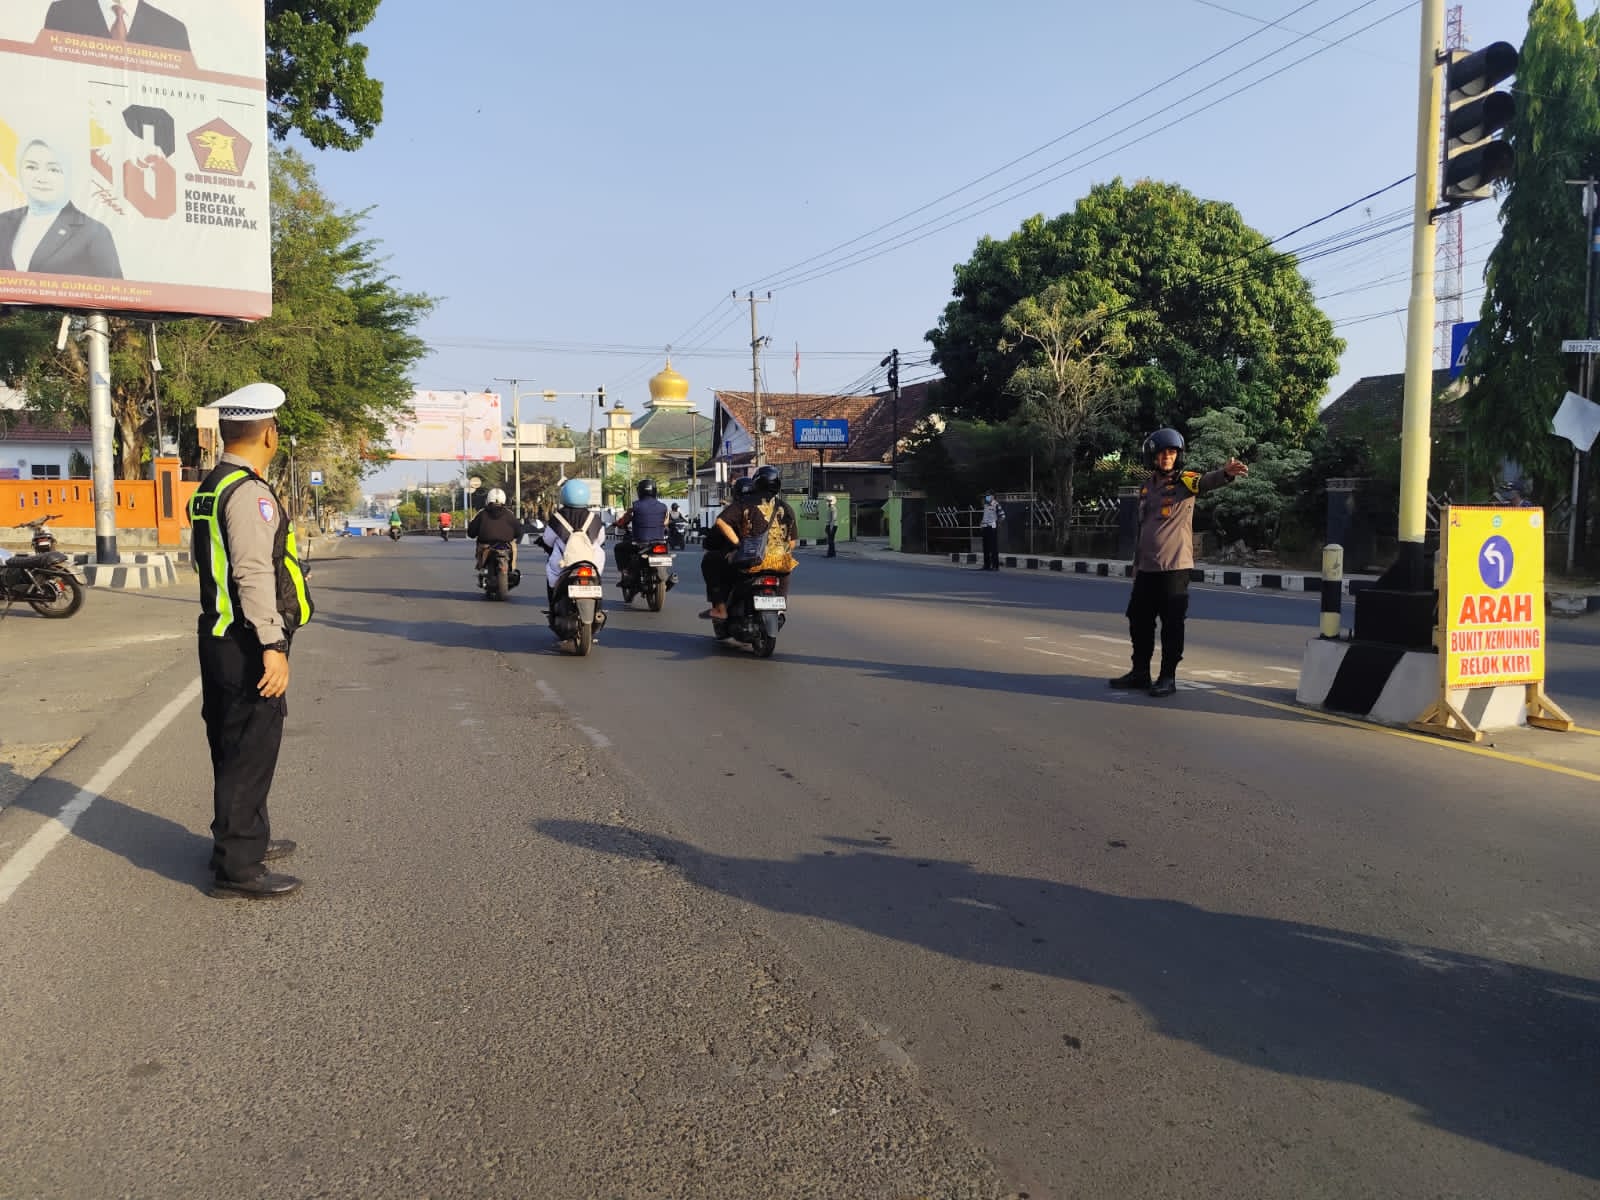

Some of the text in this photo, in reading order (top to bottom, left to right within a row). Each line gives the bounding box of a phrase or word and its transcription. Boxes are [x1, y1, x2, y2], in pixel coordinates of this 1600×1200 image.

[52, 45, 80, 55] KETUA
[81, 49, 108, 59] UMUM
[64, 37, 123, 53] PRABOWO
[126, 47, 182, 62] SUBIANTO
[184, 172, 257, 190] GERINDRA
[184, 189, 236, 205] KOMPAK
[185, 201, 246, 217] BERGERAK
[185, 212, 257, 230] BERDAMPAK
[1458, 594, 1533, 626] ARAH
[1451, 629, 1541, 652] BUKIT KEMUNING
[1459, 655, 1531, 676] BELOK KIRI
